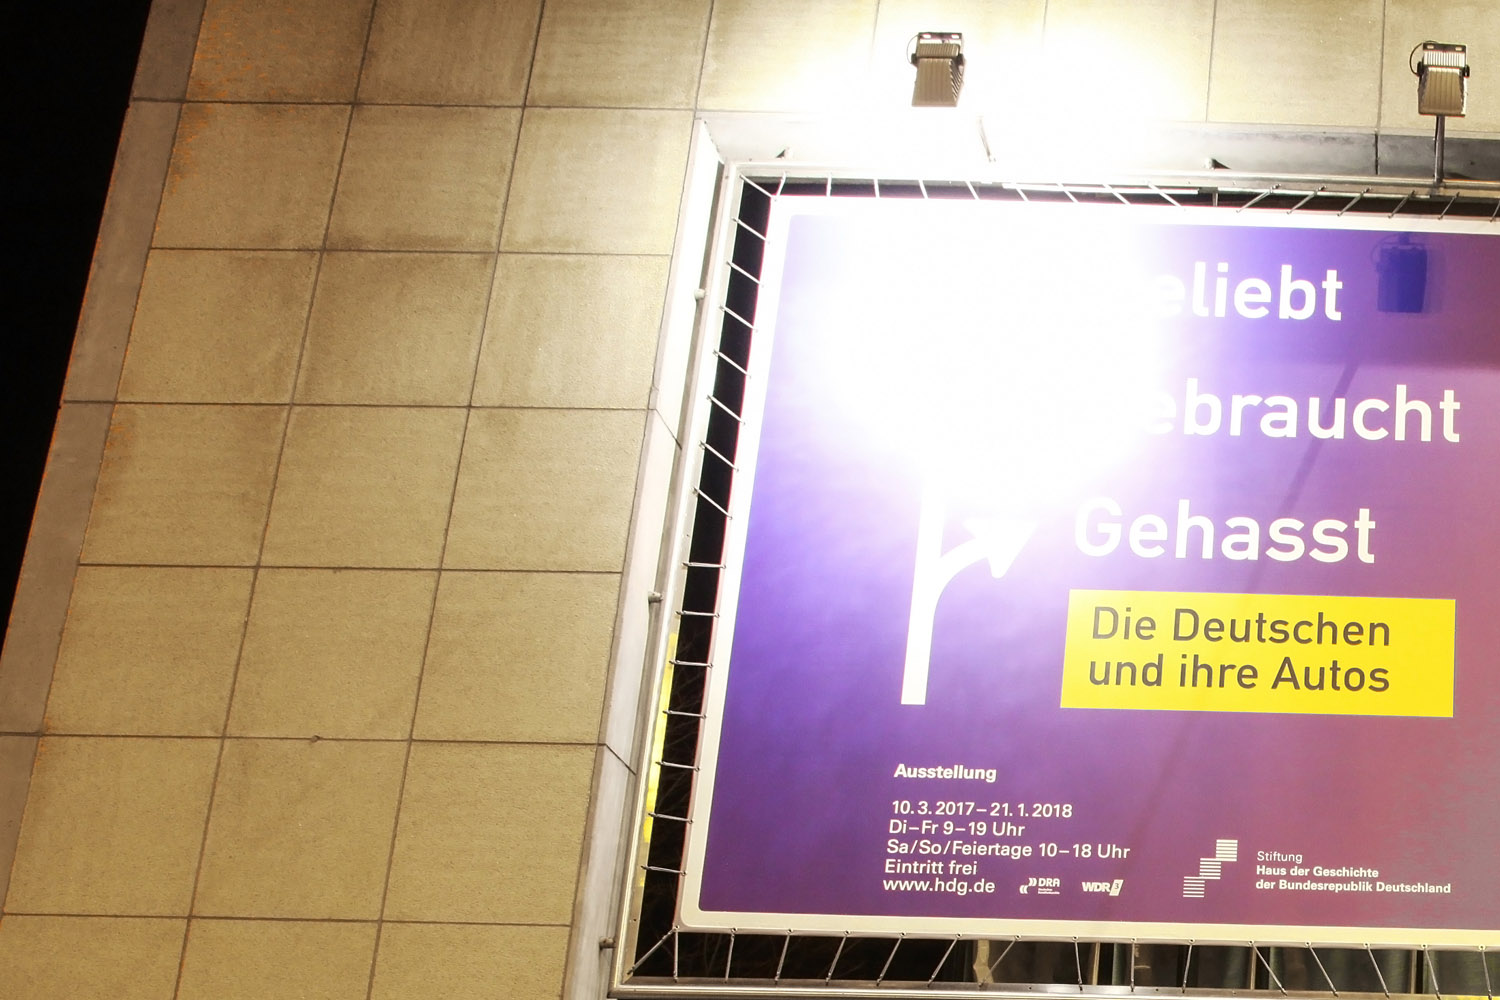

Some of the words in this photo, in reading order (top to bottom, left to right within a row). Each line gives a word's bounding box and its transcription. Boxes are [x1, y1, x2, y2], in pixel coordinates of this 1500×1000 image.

[1150, 261, 1343, 321] eliebt
[1143, 378, 1461, 444] ebraucht
[1074, 497, 1377, 564] Gehasst
[1090, 605, 1157, 641] Die
[1172, 607, 1391, 647] Deutschen
[1088, 653, 1165, 687] und
[1179, 654, 1259, 690] ihre
[1272, 657, 1391, 693] Autos
[893, 763, 997, 783] Ausstellung
[992, 821, 1025, 837] Uhr
[1097, 843, 1131, 859] Uhr
[1256, 851, 1303, 864] Stiftung
[884, 859, 944, 874] Eintritt
[948, 860, 978, 875] frei
[1256, 865, 1287, 876] Haus
[1290, 865, 1311, 877] der
[1312, 866, 1379, 878] Geschichte
[882, 878, 996, 896] www.hdg.de
[1038, 877, 1060, 888] DRA
[1255, 879, 1277, 890] der
[1279, 879, 1373, 893] Bundesrepublik
[1376, 881, 1452, 894] Deutschland
